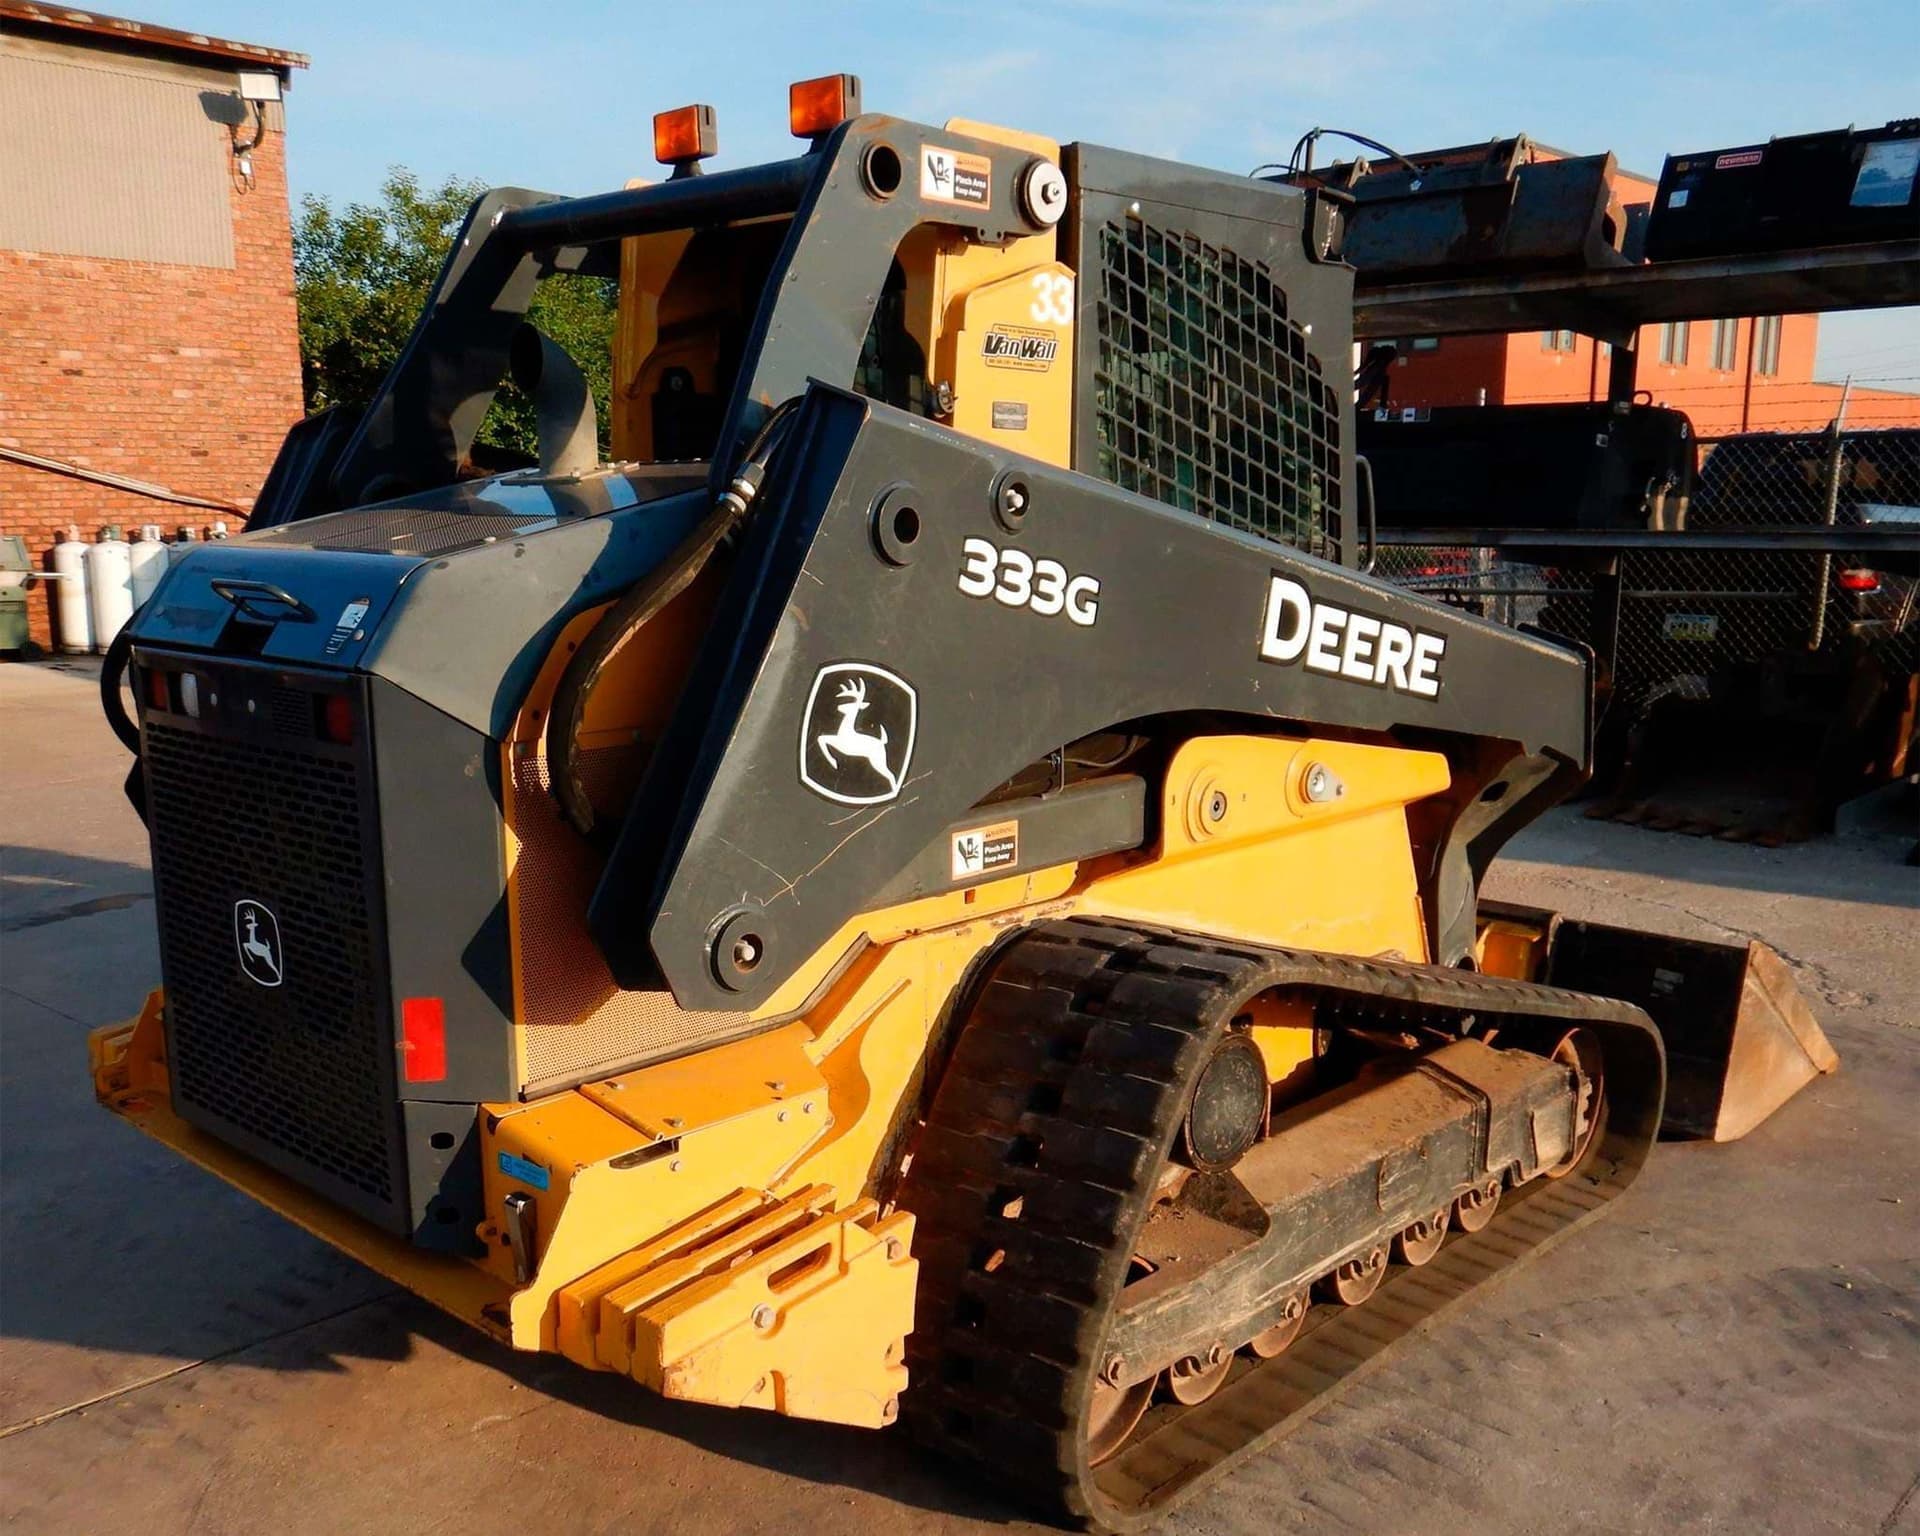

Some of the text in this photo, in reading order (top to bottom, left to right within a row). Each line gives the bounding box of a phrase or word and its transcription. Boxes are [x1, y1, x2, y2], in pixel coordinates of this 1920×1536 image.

[1031, 272, 1073, 326] 33
[958, 537, 1100, 626] 333G
[1261, 576, 1446, 698] DEERE
